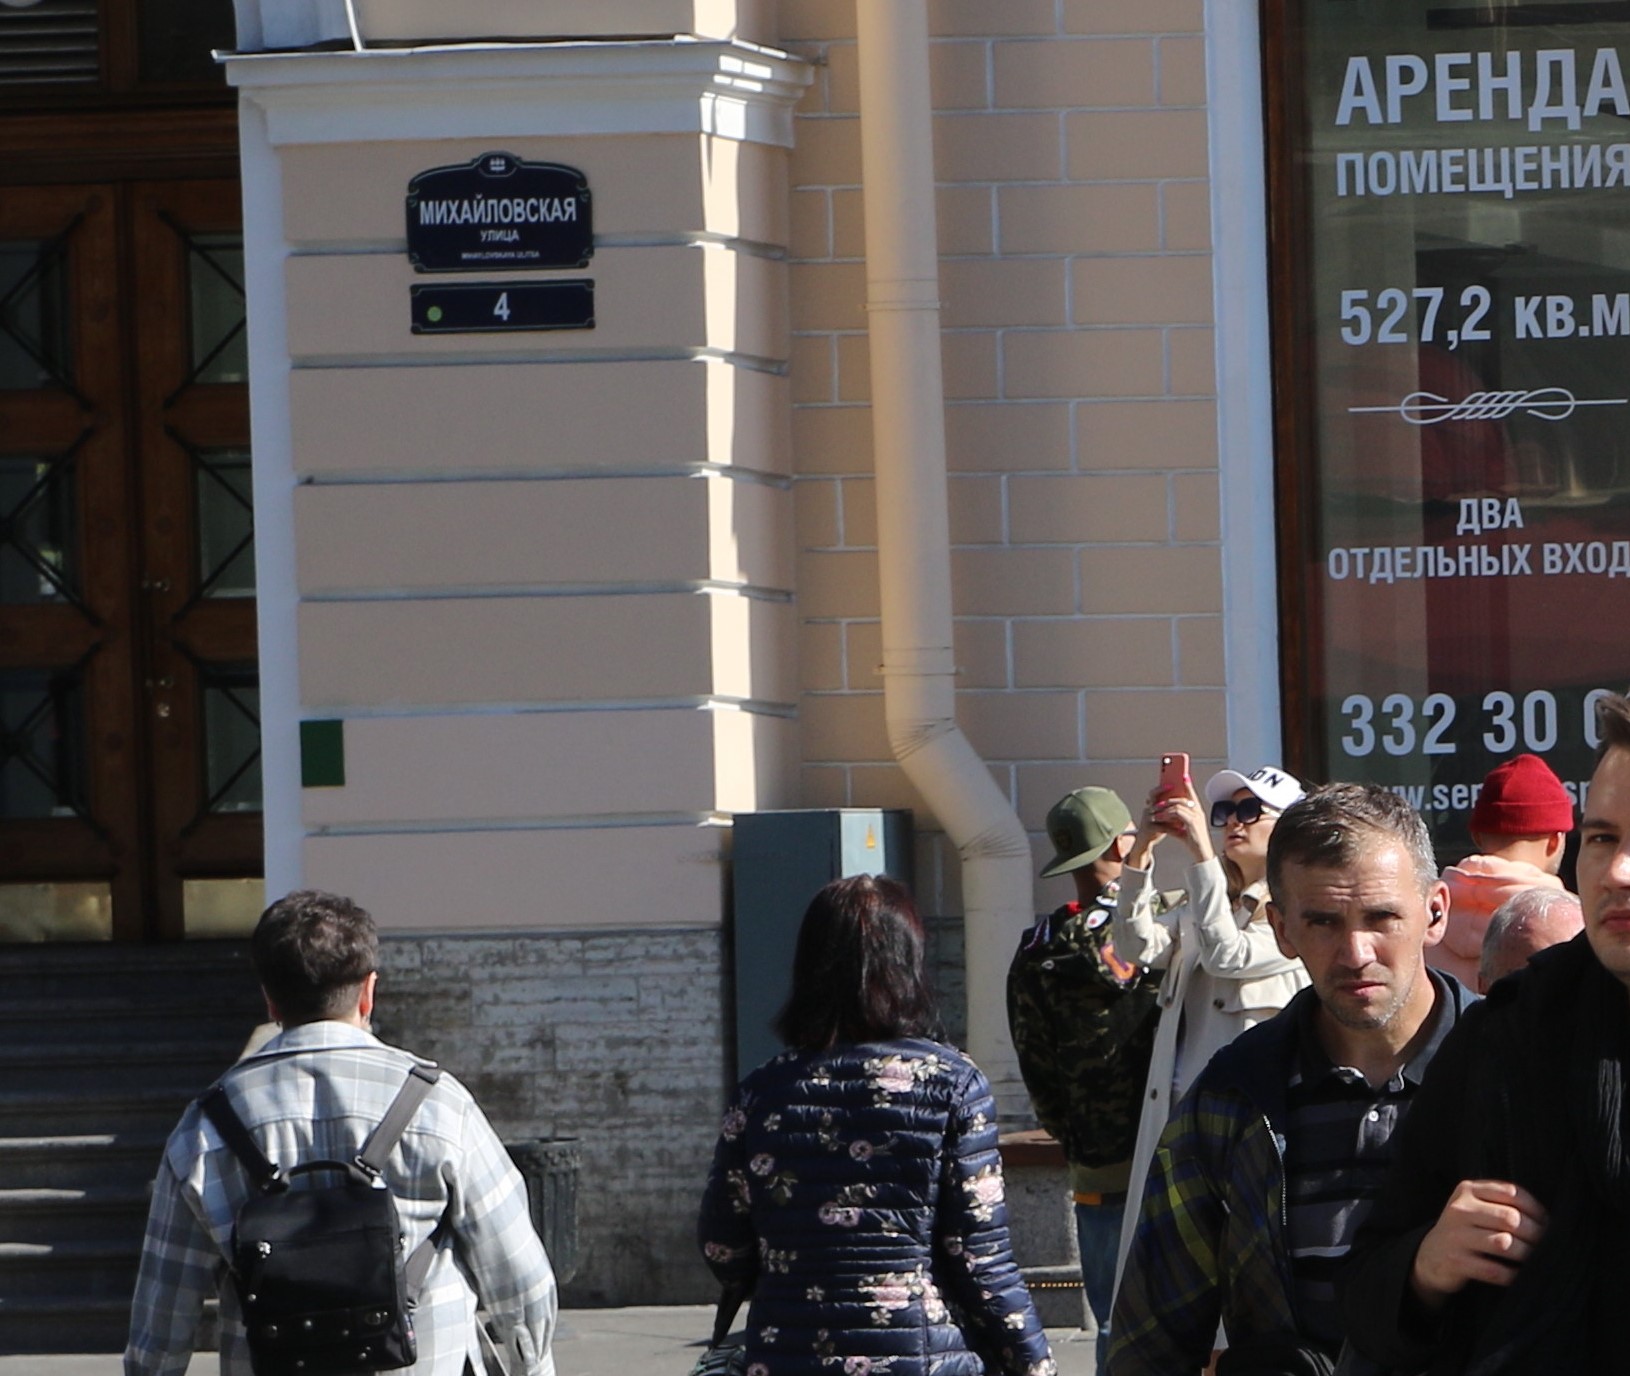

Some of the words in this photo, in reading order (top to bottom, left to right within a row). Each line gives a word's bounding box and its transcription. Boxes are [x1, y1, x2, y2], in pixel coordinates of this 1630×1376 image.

[1335, 48, 1630, 131] АРЕНДА
[420, 193, 577, 226] МИХАЙЛОВСКАЯ
[480, 229, 520, 243] УЛИЦА
[493, 292, 511, 321] 4
[1340, 285, 1491, 350] 527,2
[1457, 498, 1523, 535] ДВА
[1328, 543, 1532, 583] ОТДЕЛЬНЫХ
[1341, 694, 1456, 757] 332
[1483, 690, 1557, 754] 30
